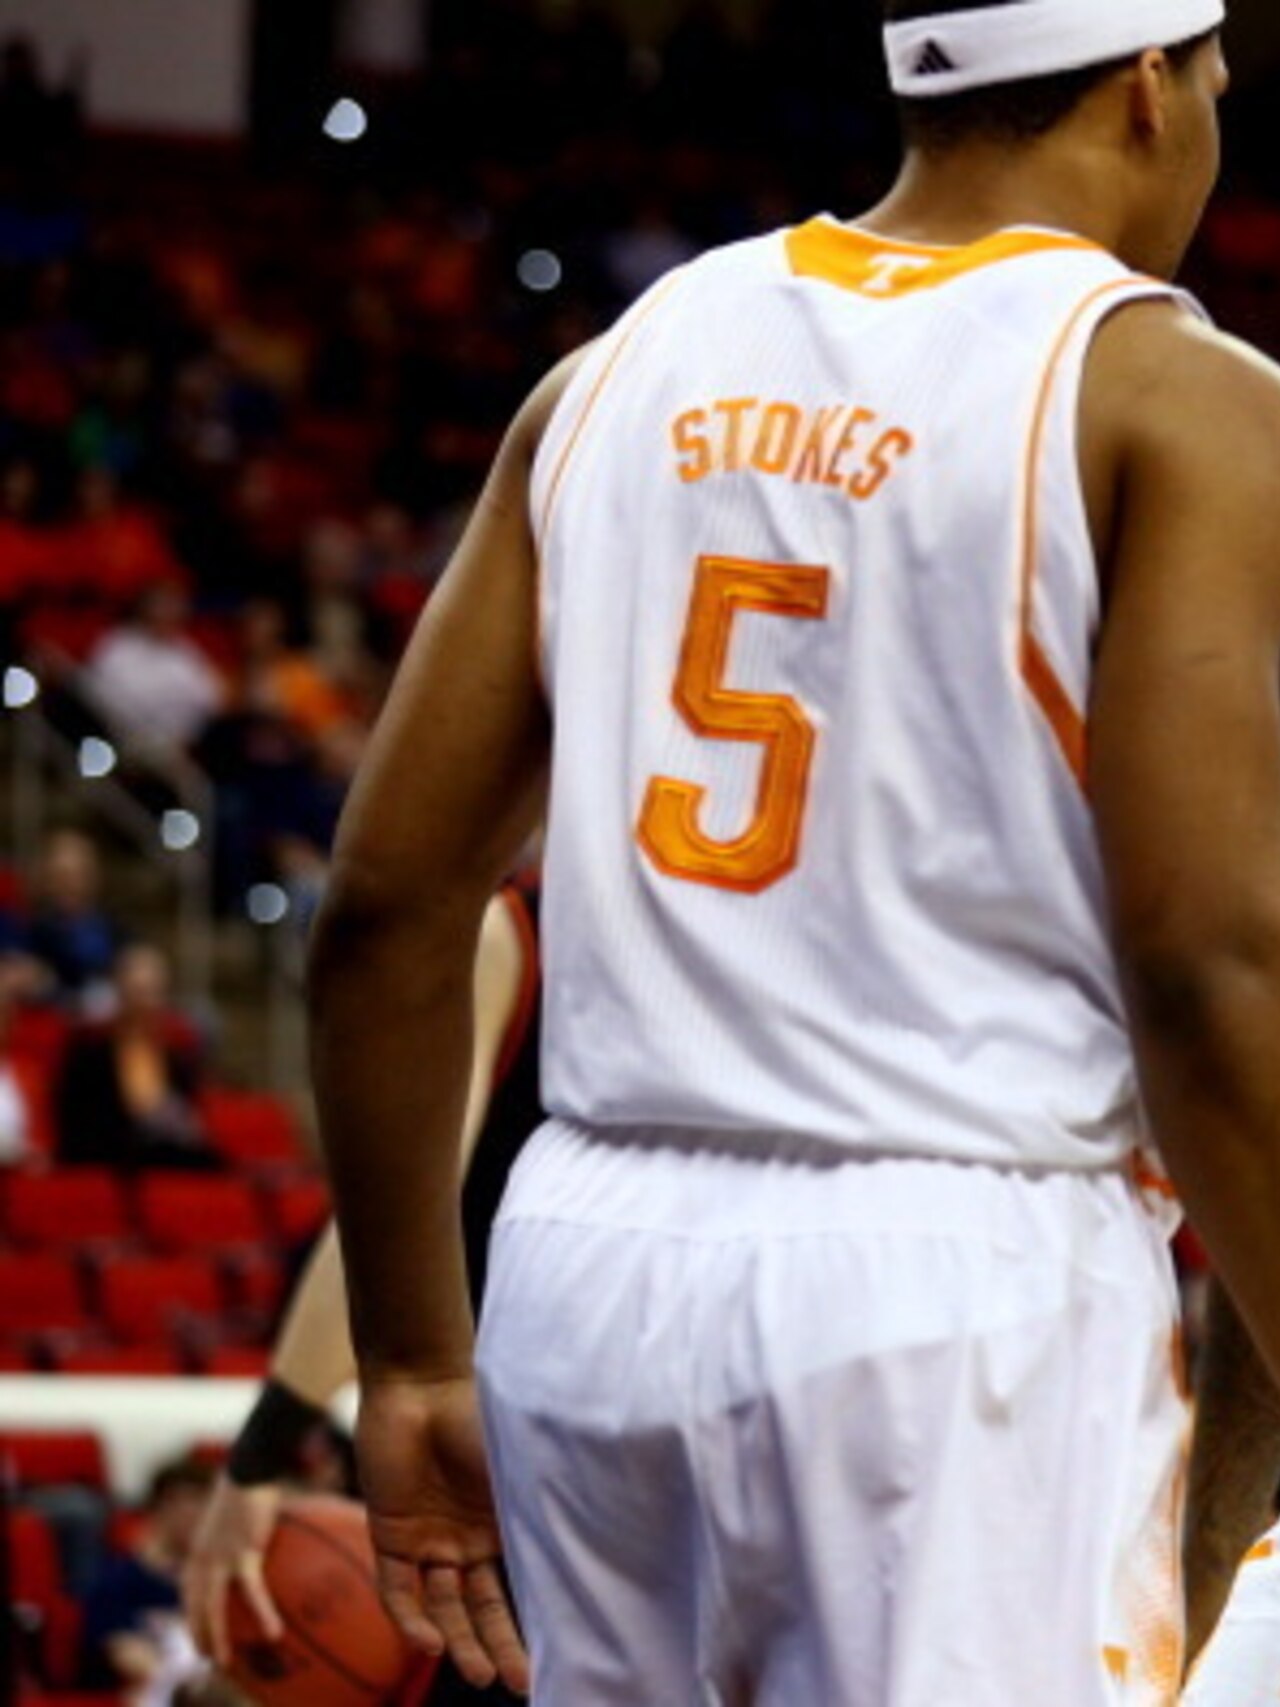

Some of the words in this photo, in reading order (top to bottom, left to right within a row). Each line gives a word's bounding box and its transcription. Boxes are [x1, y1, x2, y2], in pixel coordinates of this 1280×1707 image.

[862, 254, 932, 292] T
[671, 396, 912, 502] STOKES
[635, 553, 830, 894] 5
